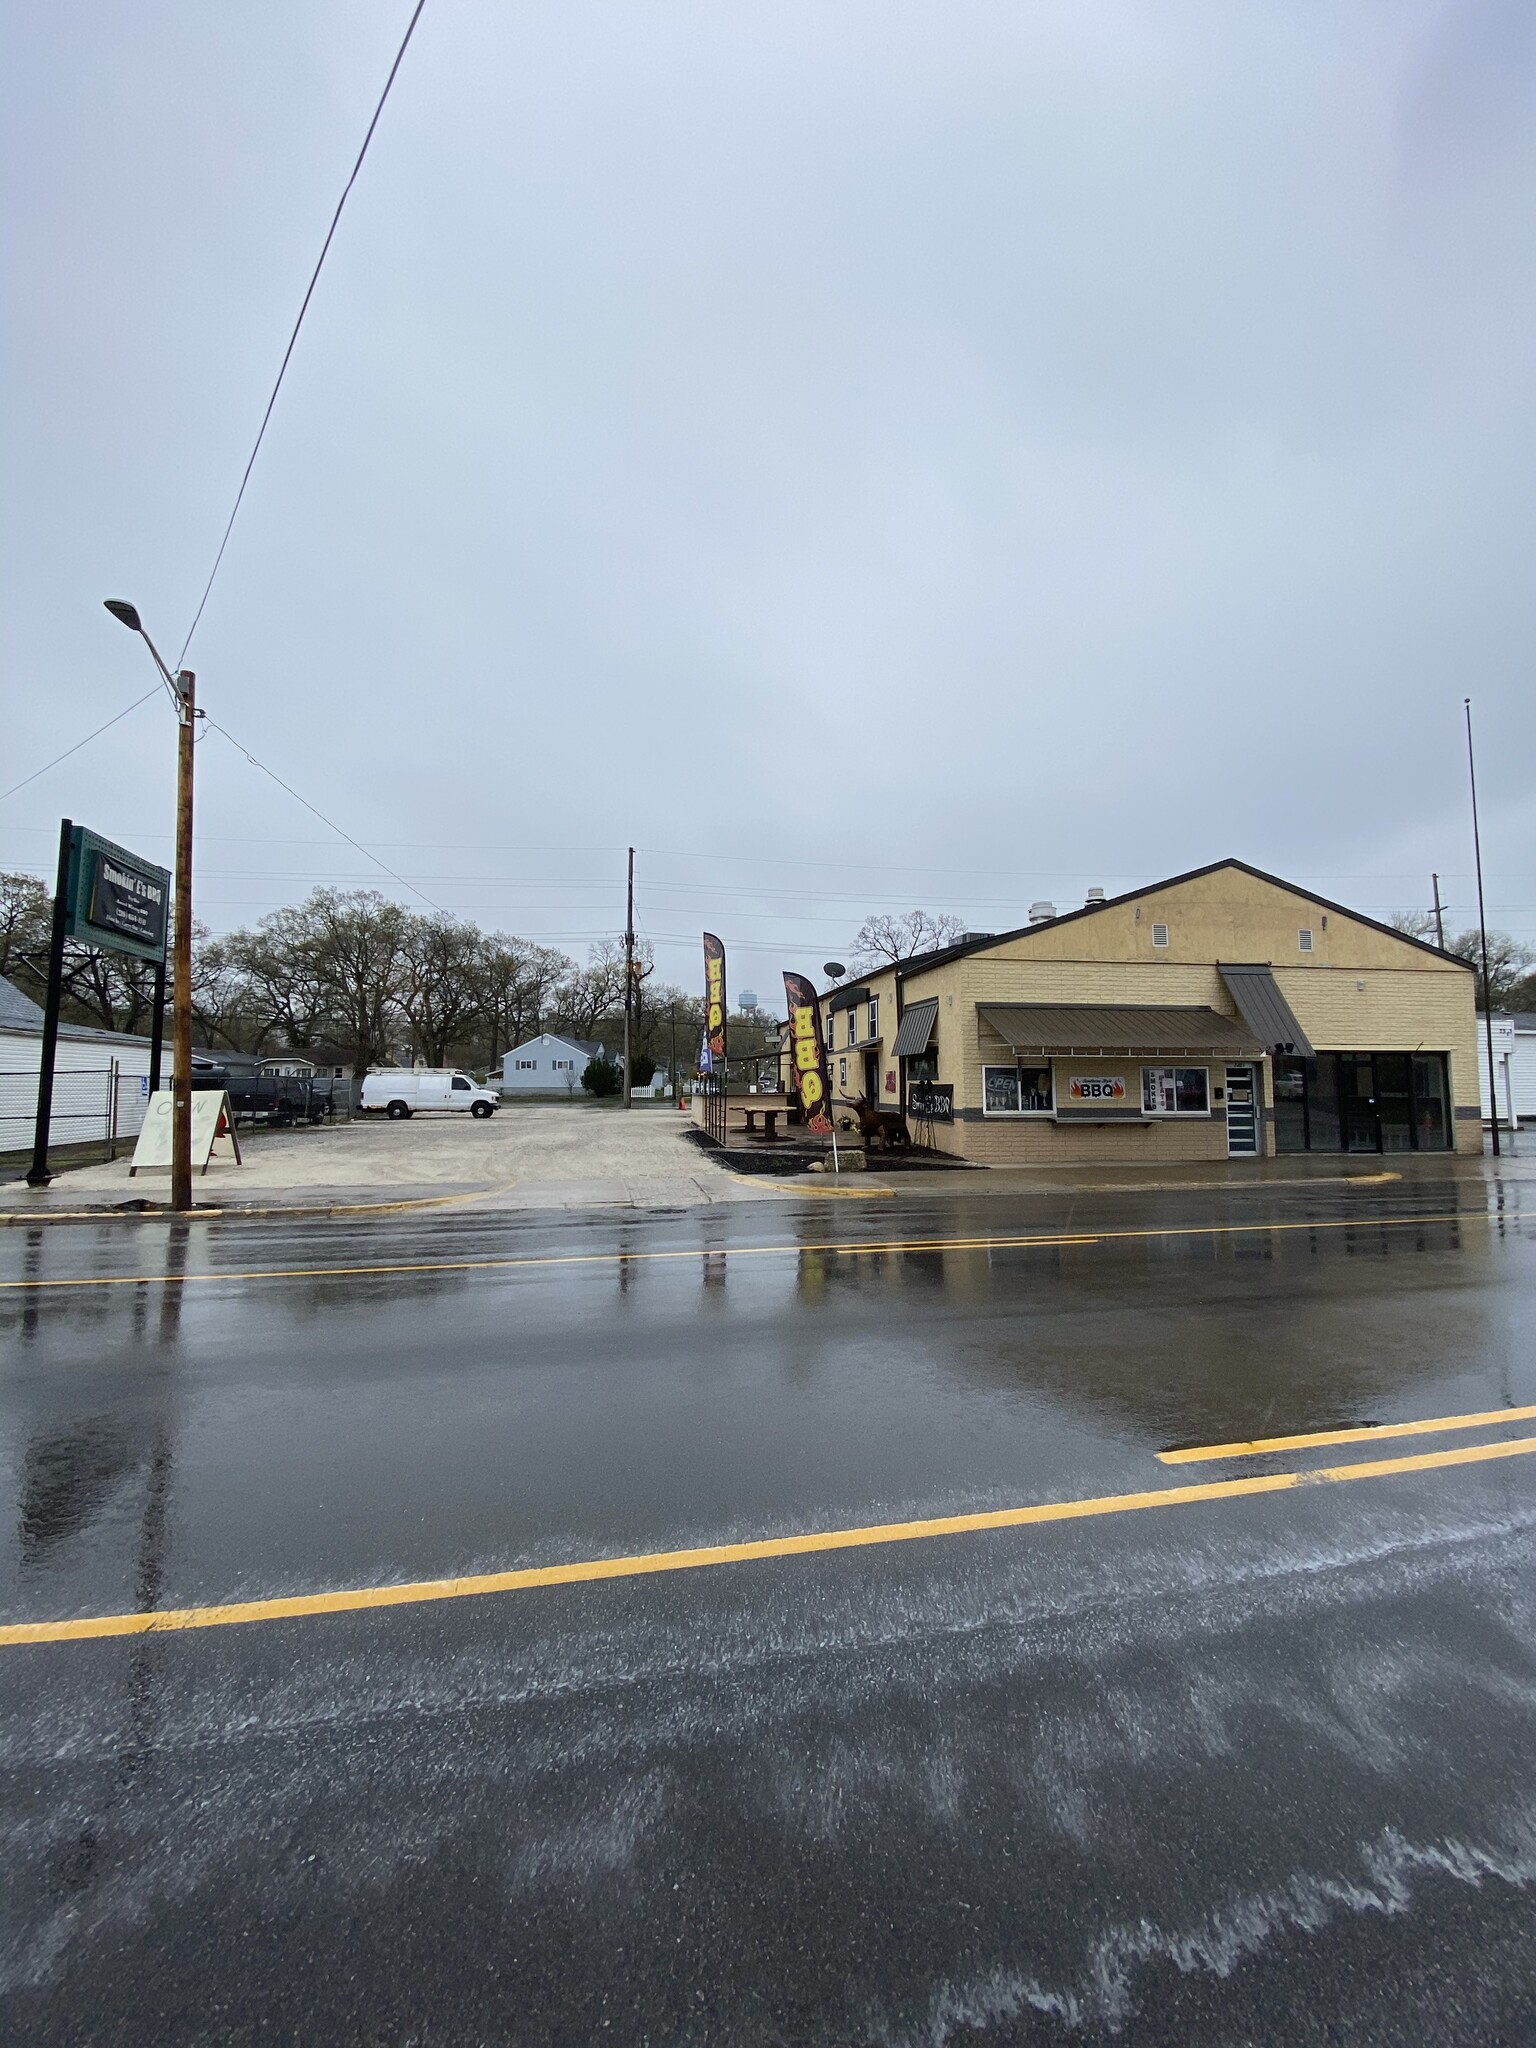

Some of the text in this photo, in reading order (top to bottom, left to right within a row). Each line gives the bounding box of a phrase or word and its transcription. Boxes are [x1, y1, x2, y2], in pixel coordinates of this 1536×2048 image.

[103, 863, 162, 905] Smokin' E's BBQ
[989, 1077, 1016, 1090] OPEN
[1080, 1084, 1114, 1098] BBQ
[157, 1101, 207, 1115] ON
[934, 1095, 951, 1114] BBQ
